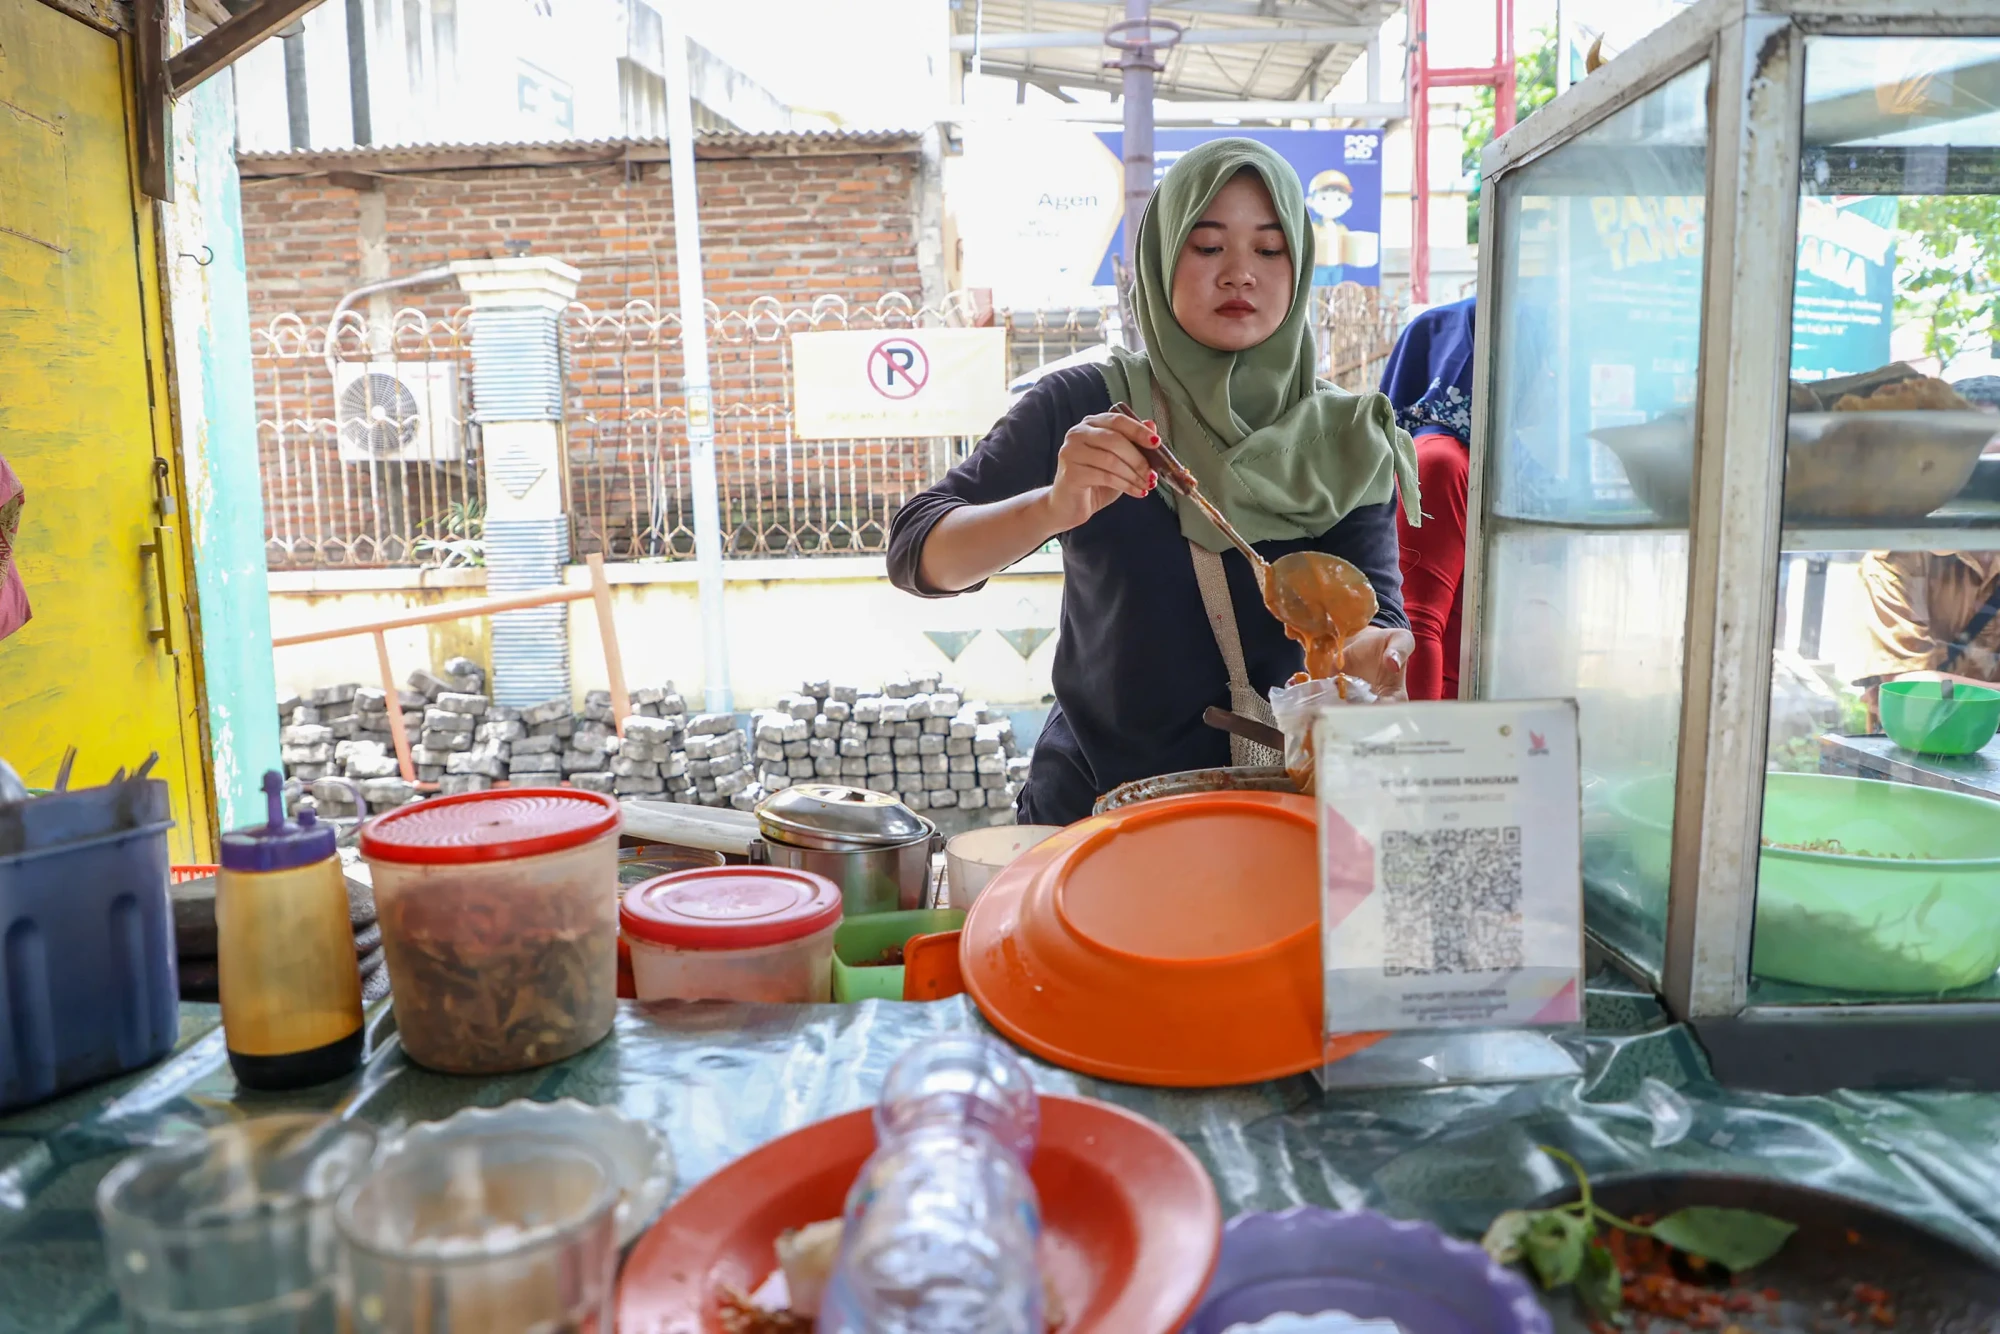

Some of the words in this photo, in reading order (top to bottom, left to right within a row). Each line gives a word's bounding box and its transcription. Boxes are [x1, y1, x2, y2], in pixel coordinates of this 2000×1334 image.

[1344, 134, 1379, 148] POS
[1039, 193, 1098, 210] Agen
[886, 348, 914, 386] P
